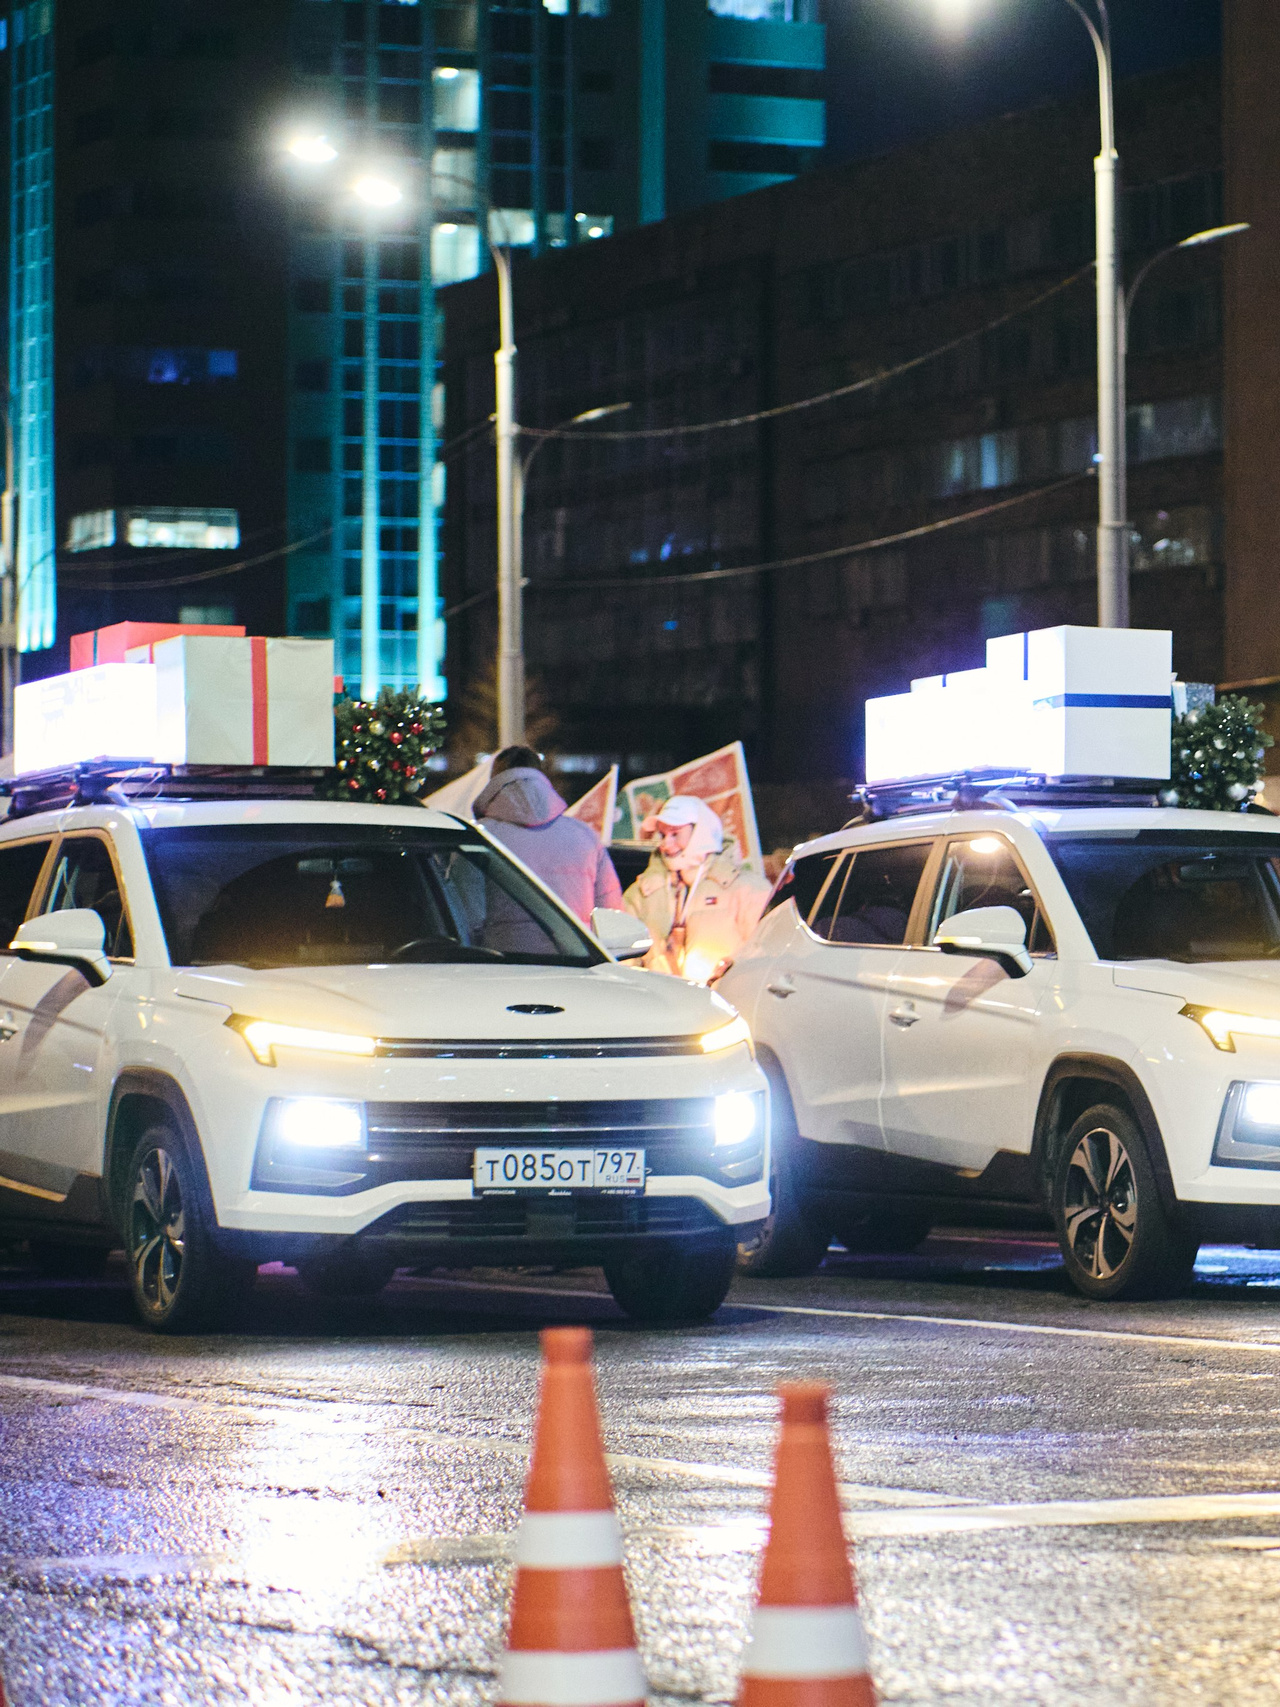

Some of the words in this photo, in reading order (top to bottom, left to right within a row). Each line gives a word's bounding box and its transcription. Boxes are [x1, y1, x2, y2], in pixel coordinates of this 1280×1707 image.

[485, 1153, 591, 1181] Т085ОТ
[597, 1152, 636, 1174] 797
[605, 1175, 625, 1183] RUS
